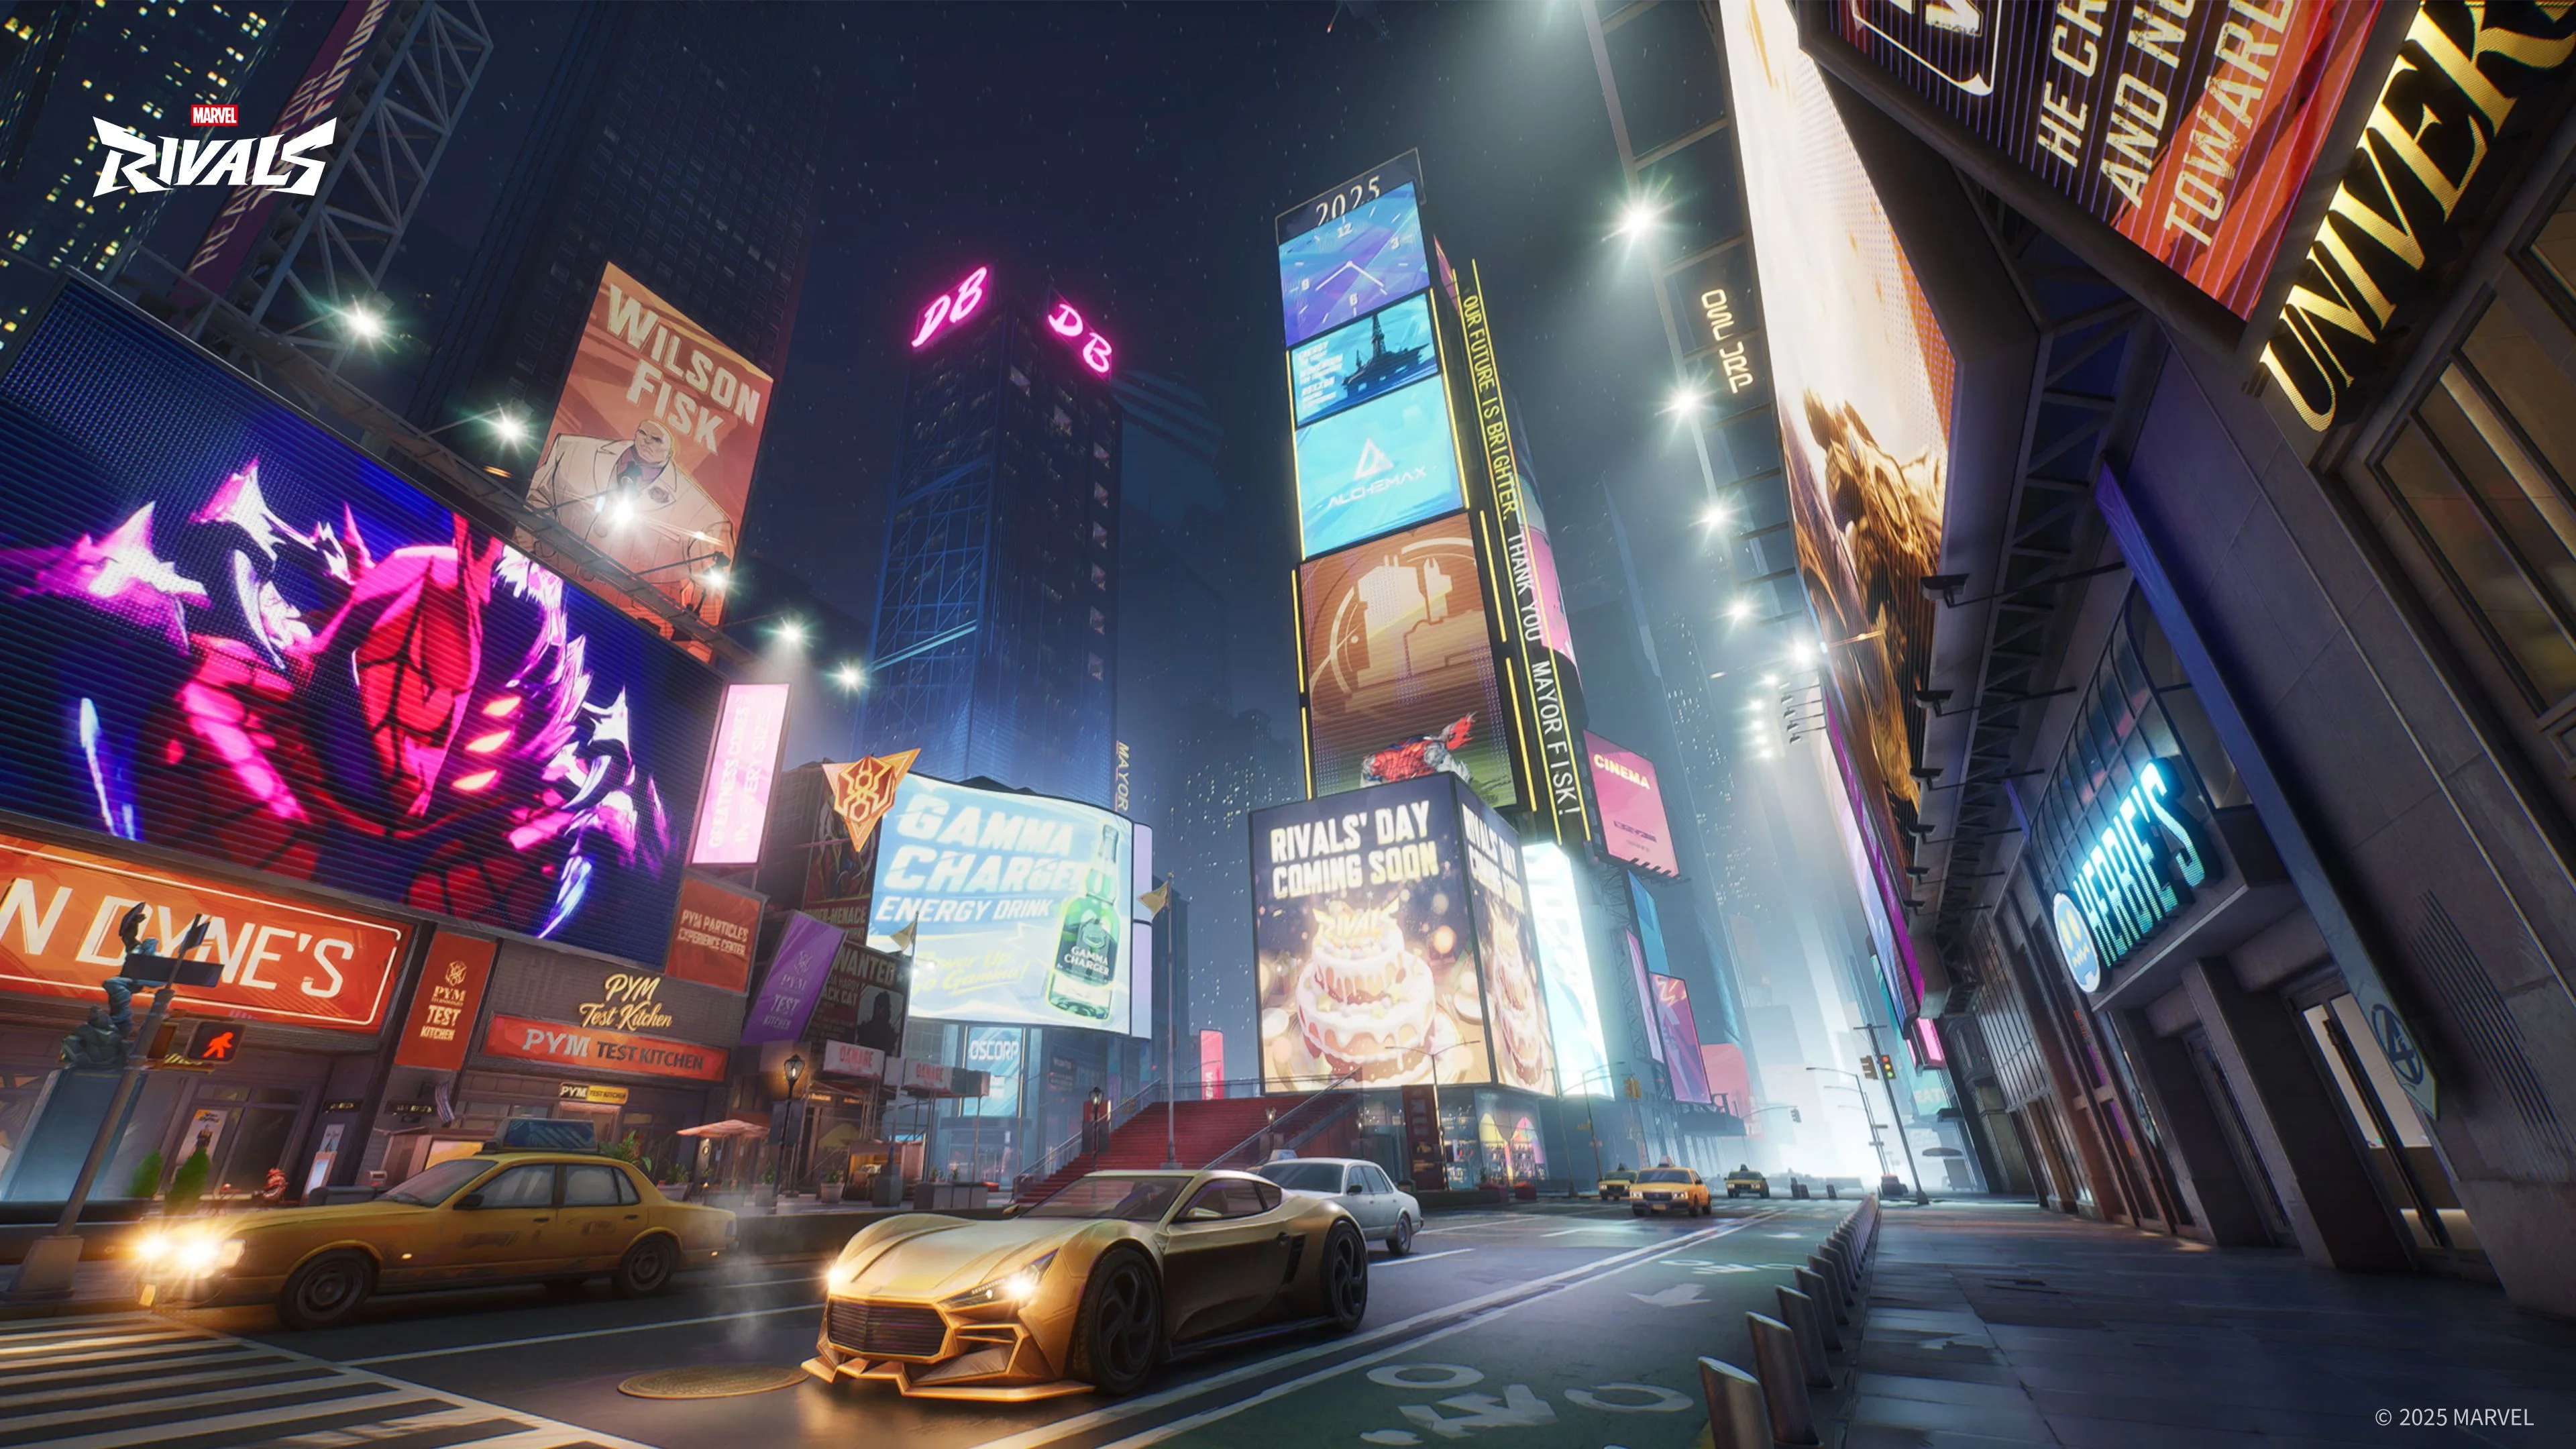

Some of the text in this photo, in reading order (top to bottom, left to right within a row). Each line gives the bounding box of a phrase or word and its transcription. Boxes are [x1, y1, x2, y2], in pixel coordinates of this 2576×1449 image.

[301, 0, 392, 125] FUTUR
[2100, 73, 2167, 210] AND
[1316, 175, 1380, 227] 2025
[2259, 0, 2576, 431] UNIVER
[1337, 223, 1353, 238] 12
[911, 266, 987, 348] DB
[1463, 295, 1485, 329] OUR
[606, 283, 761, 426] WILSON
[1048, 303, 1112, 373] DB
[1469, 325, 1495, 392] FUTURE
[625, 360, 724, 455] FISK
[1482, 396, 1500, 419] IS
[1487, 421, 1519, 521] BRIGHTER.
[1507, 531, 1535, 596] THANK
[1519, 597, 1544, 642] YOU
[1532, 660, 1563, 735] MAYOR
[1118, 741, 1130, 812] MAYOR
[1548, 740, 1581, 816] FISK!
[1593, 753, 1651, 790] CINEMA
[896, 793, 1073, 857] GAMMA
[1269, 800, 1430, 864] RIVALS' DAY
[1273, 841, 1440, 900] COMING SOON
[2072, 762, 2206, 969] HERBIE'S
[680, 909, 749, 943] PYM PARTICLES
[874, 896, 1054, 924] ENERGY DRINK
[75, 895, 356, 999] DYNE'S
[834, 947, 897, 985] WANTED
[1063, 953, 1110, 977] CHARGER
[1071, 945, 1109, 966] GAMMA
[433, 985, 467, 1002] PYM
[604, 973, 662, 1004] PYM
[781, 974, 808, 991] PYM
[841, 989, 859, 1006] CAT
[426, 1004, 462, 1027] TEST
[578, 1000, 674, 1032] Test Kitchen
[762, 1014, 793, 1032] KITCHEN
[770, 994, 802, 1016] TEST
[420, 1025, 455, 1042] KITCHEN
[522, 1028, 704, 1071] PYM TEST KITCHEN
[969, 1040, 1020, 1061] OSCORP
[839, 1045, 874, 1067] DAMAGE
[559, 1085, 627, 1100] PYM TEST KITCHEN
